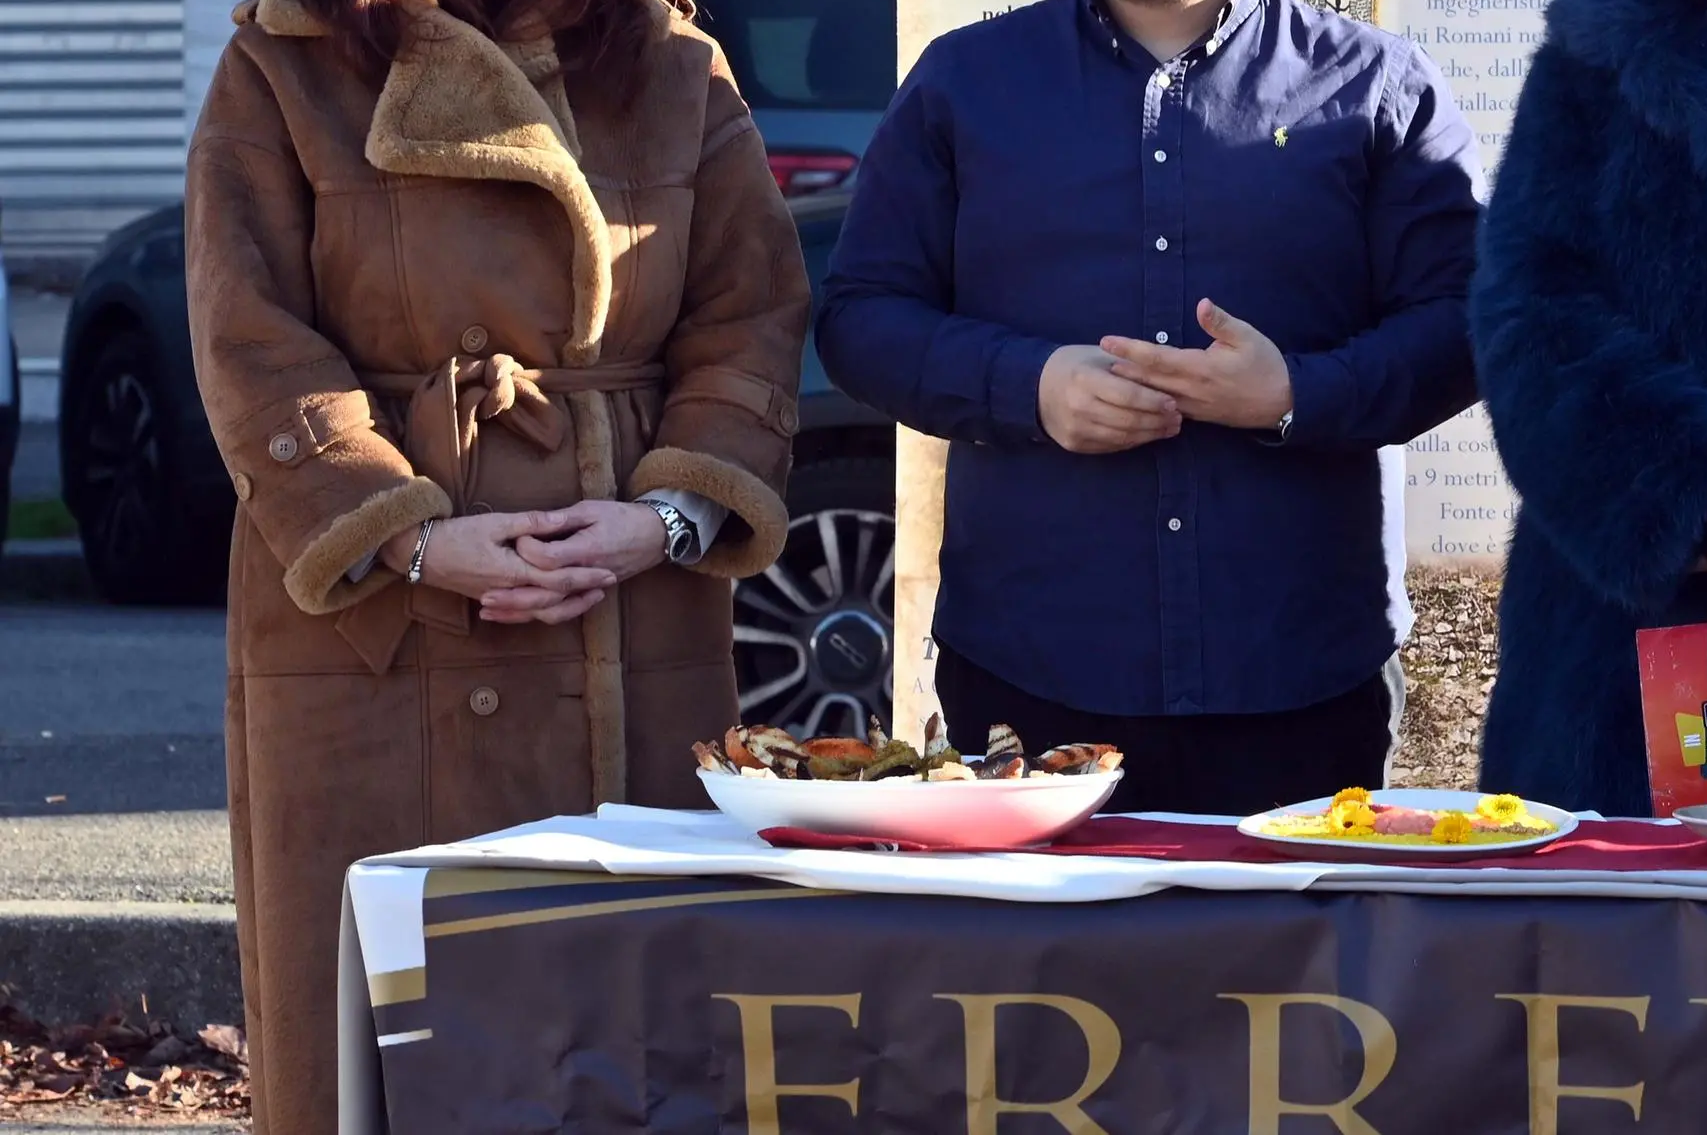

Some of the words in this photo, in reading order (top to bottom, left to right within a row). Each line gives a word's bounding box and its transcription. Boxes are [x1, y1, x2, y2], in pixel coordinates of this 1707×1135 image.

[1436, 26, 1512, 44] Romani
[1406, 433, 1450, 453] sulla
[1444, 471, 1498, 487] metri
[1440, 502, 1496, 520] Fonte
[1432, 534, 1479, 554] dove
[1684, 733, 1702, 749] IN
